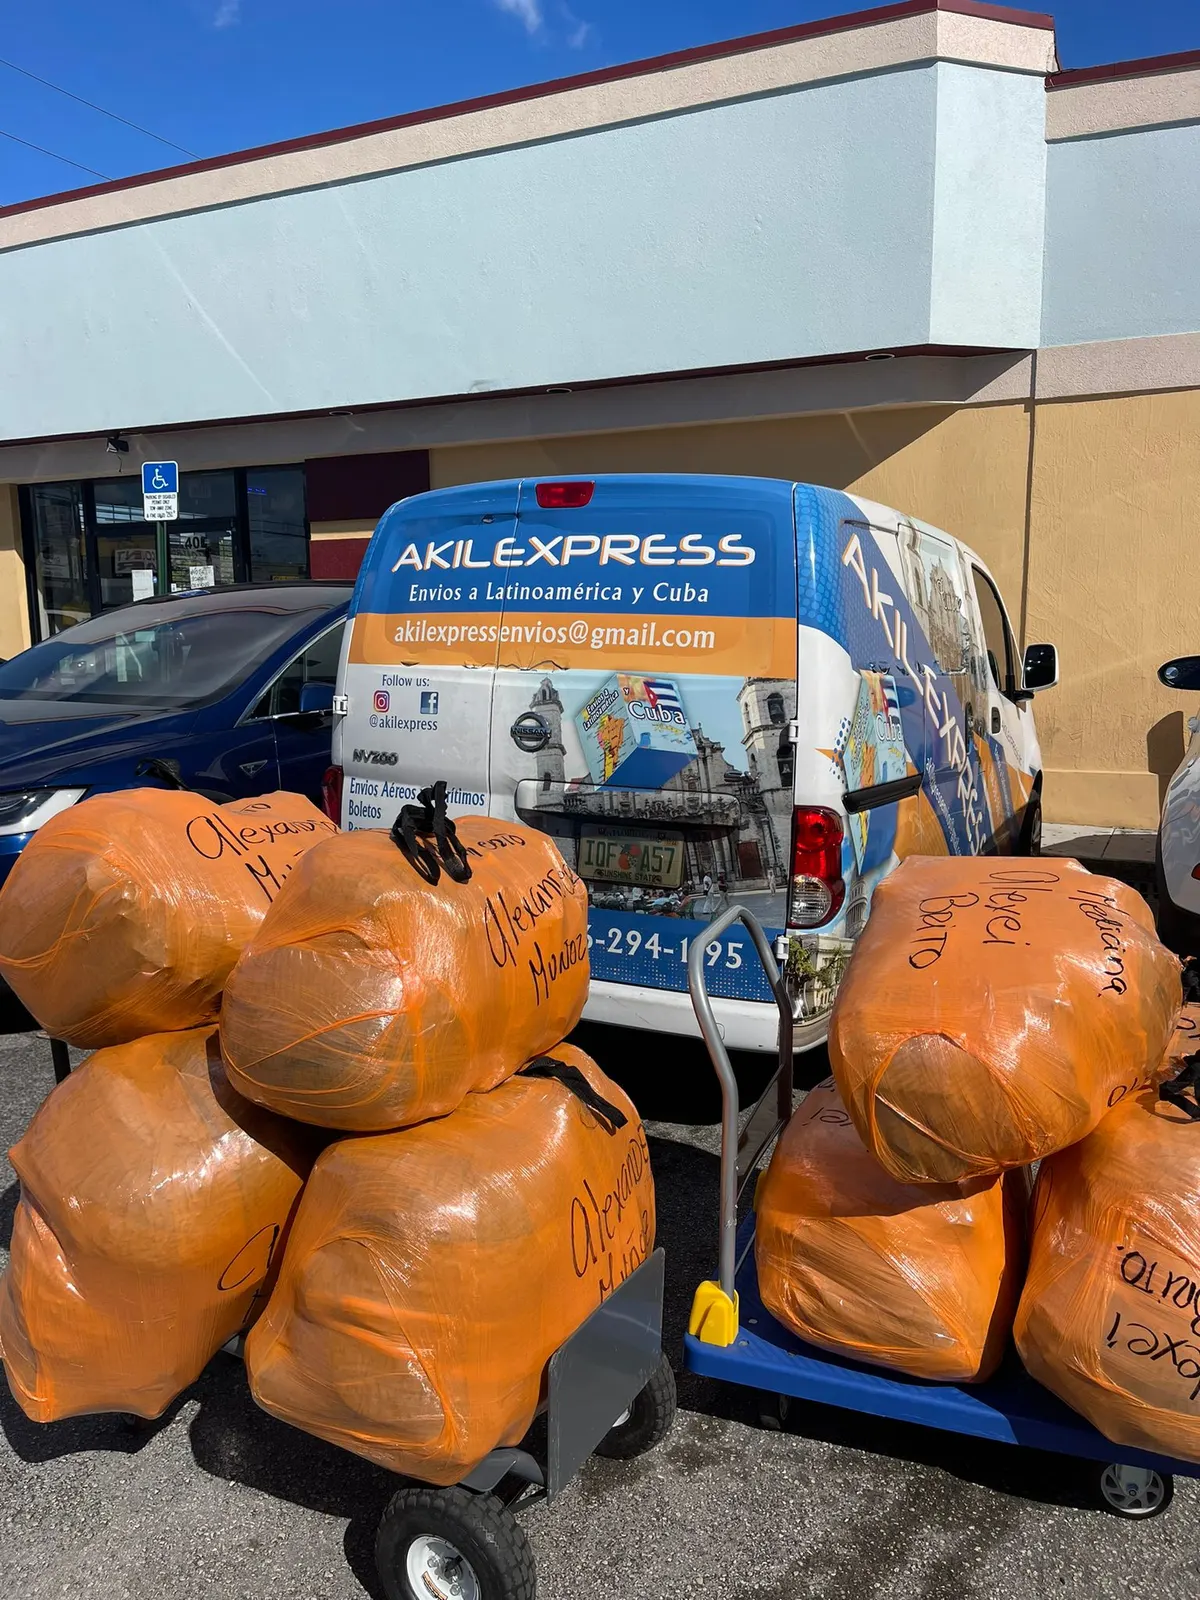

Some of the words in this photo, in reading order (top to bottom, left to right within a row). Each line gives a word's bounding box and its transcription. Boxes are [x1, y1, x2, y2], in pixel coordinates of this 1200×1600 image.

[391, 533, 756, 573] AKILEXPRESS
[409, 583, 462, 602] Envios
[468, 586, 478, 600] a
[486, 581, 622, 601] Latinoamérica
[632, 586, 644, 605] y
[652, 581, 709, 603] Cuba
[394, 619, 716, 649] akilexpressenvios@gmail.com
[382, 674, 413, 687] Follow
[416, 677, 430, 687] us:
[623, 687, 630, 695] y
[585, 691, 605, 715] Envios
[628, 700, 687, 725] Cuba
[369, 714, 438, 732] @akilexpress
[512, 726, 547, 737] NISSAN
[876, 713, 903, 742] Cuba
[352, 748, 399, 766] NV200
[349, 777, 378, 798] Envios
[381, 780, 417, 801] Aéreos
[348, 799, 382, 819] Boletos
[640, 844, 676, 875] A57
[601, 869, 633, 881] SUNSHINE
